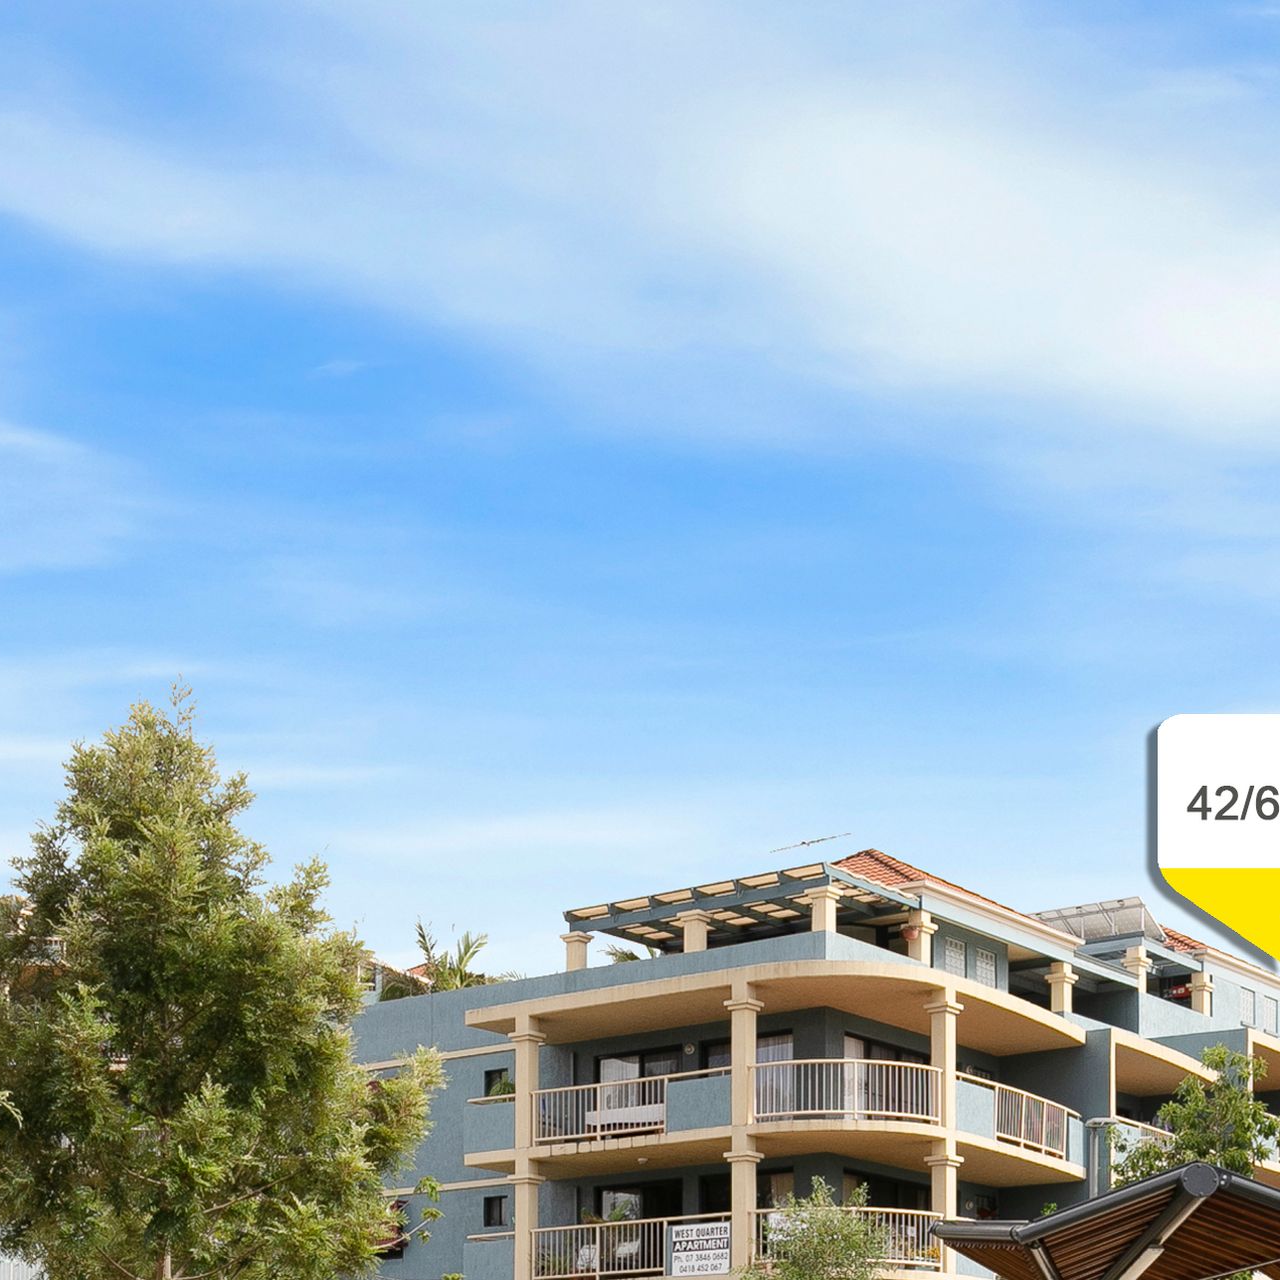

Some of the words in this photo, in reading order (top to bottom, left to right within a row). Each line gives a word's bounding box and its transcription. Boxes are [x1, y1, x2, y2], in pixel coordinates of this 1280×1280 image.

[674, 1228, 694, 1239] WEST
[695, 1226, 728, 1238] QUARTER
[674, 1238, 728, 1252] APARTMENT
[685, 1254, 693, 1263] 07
